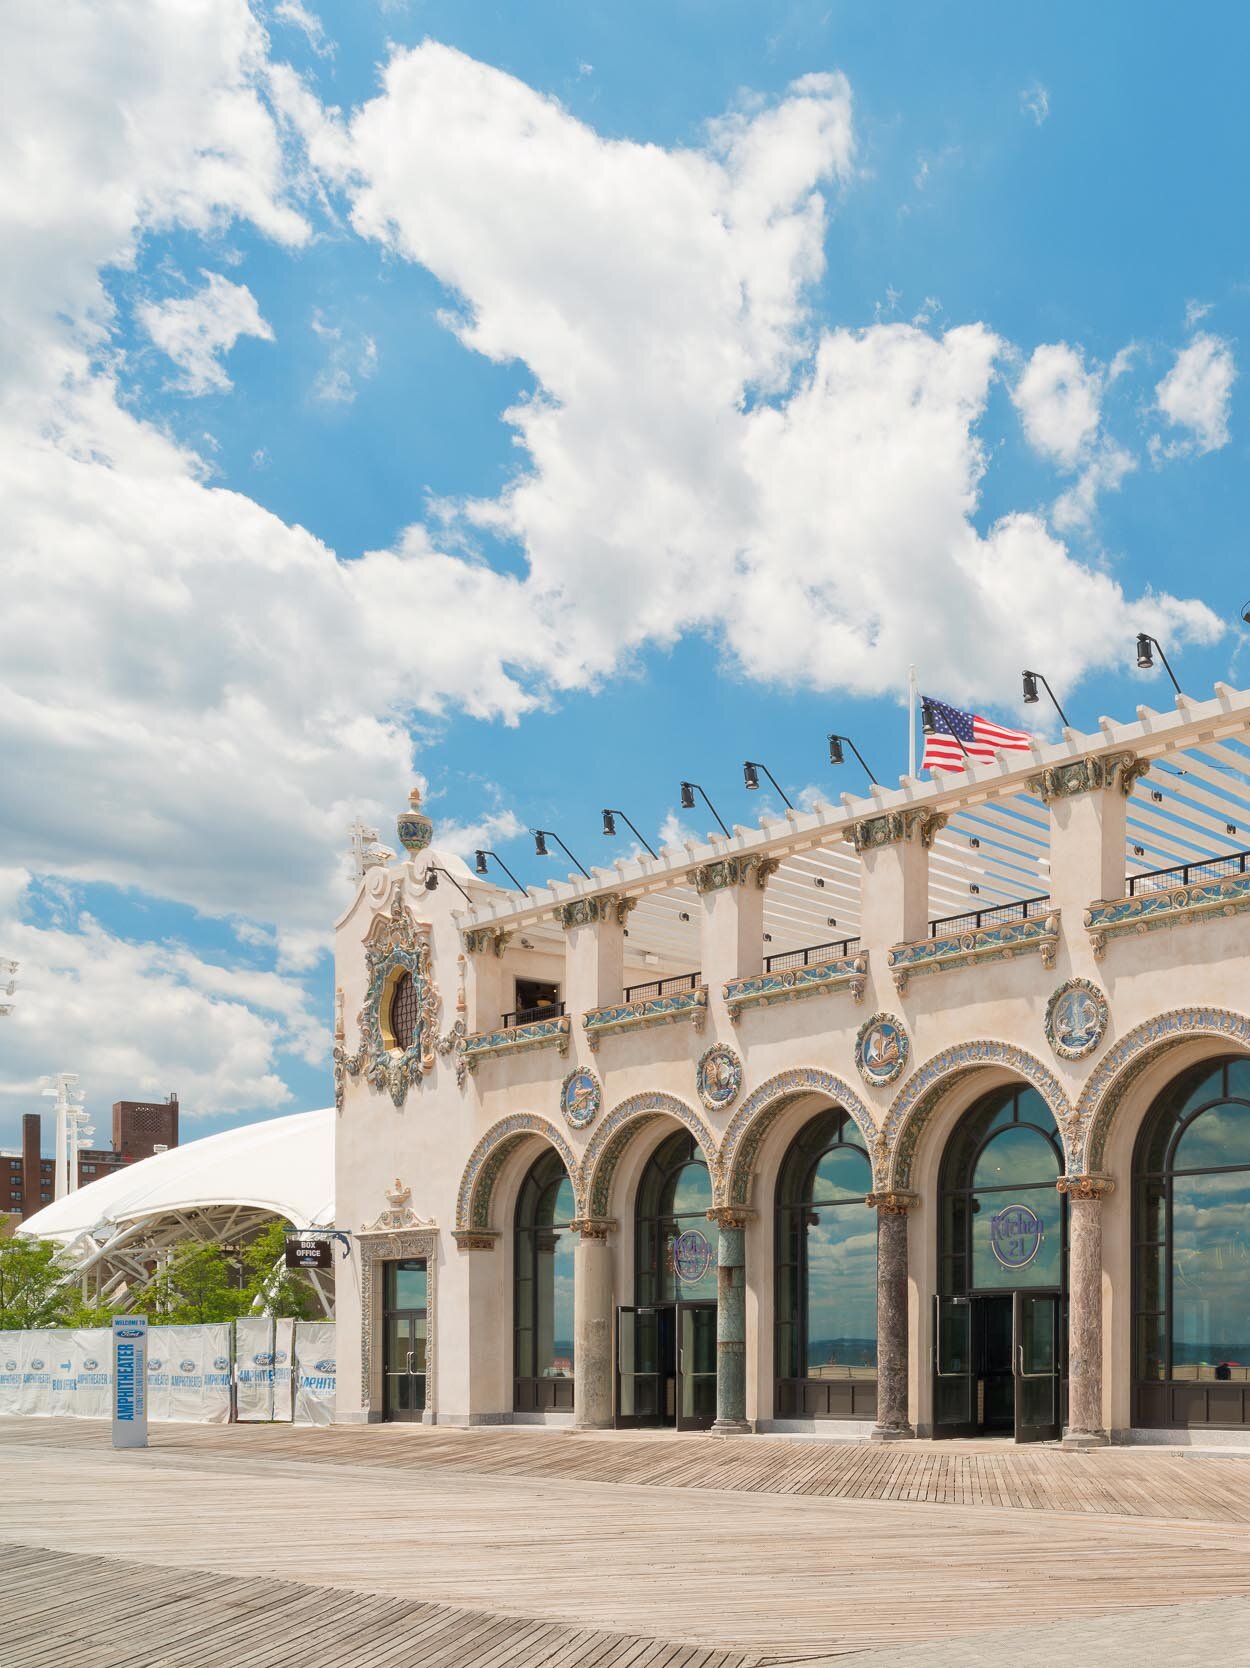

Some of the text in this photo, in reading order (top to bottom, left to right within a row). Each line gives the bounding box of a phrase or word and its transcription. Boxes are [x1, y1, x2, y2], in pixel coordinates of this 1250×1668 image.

[990, 1212, 1044, 1241] Kitchen
[301, 1241, 316, 1249] BOX
[1008, 1238, 1025, 1257] 21
[296, 1249, 321, 1257] OFFICE
[120, 1329, 141, 1338] Ford
[117, 1344, 134, 1421] AMPHITHEATER
